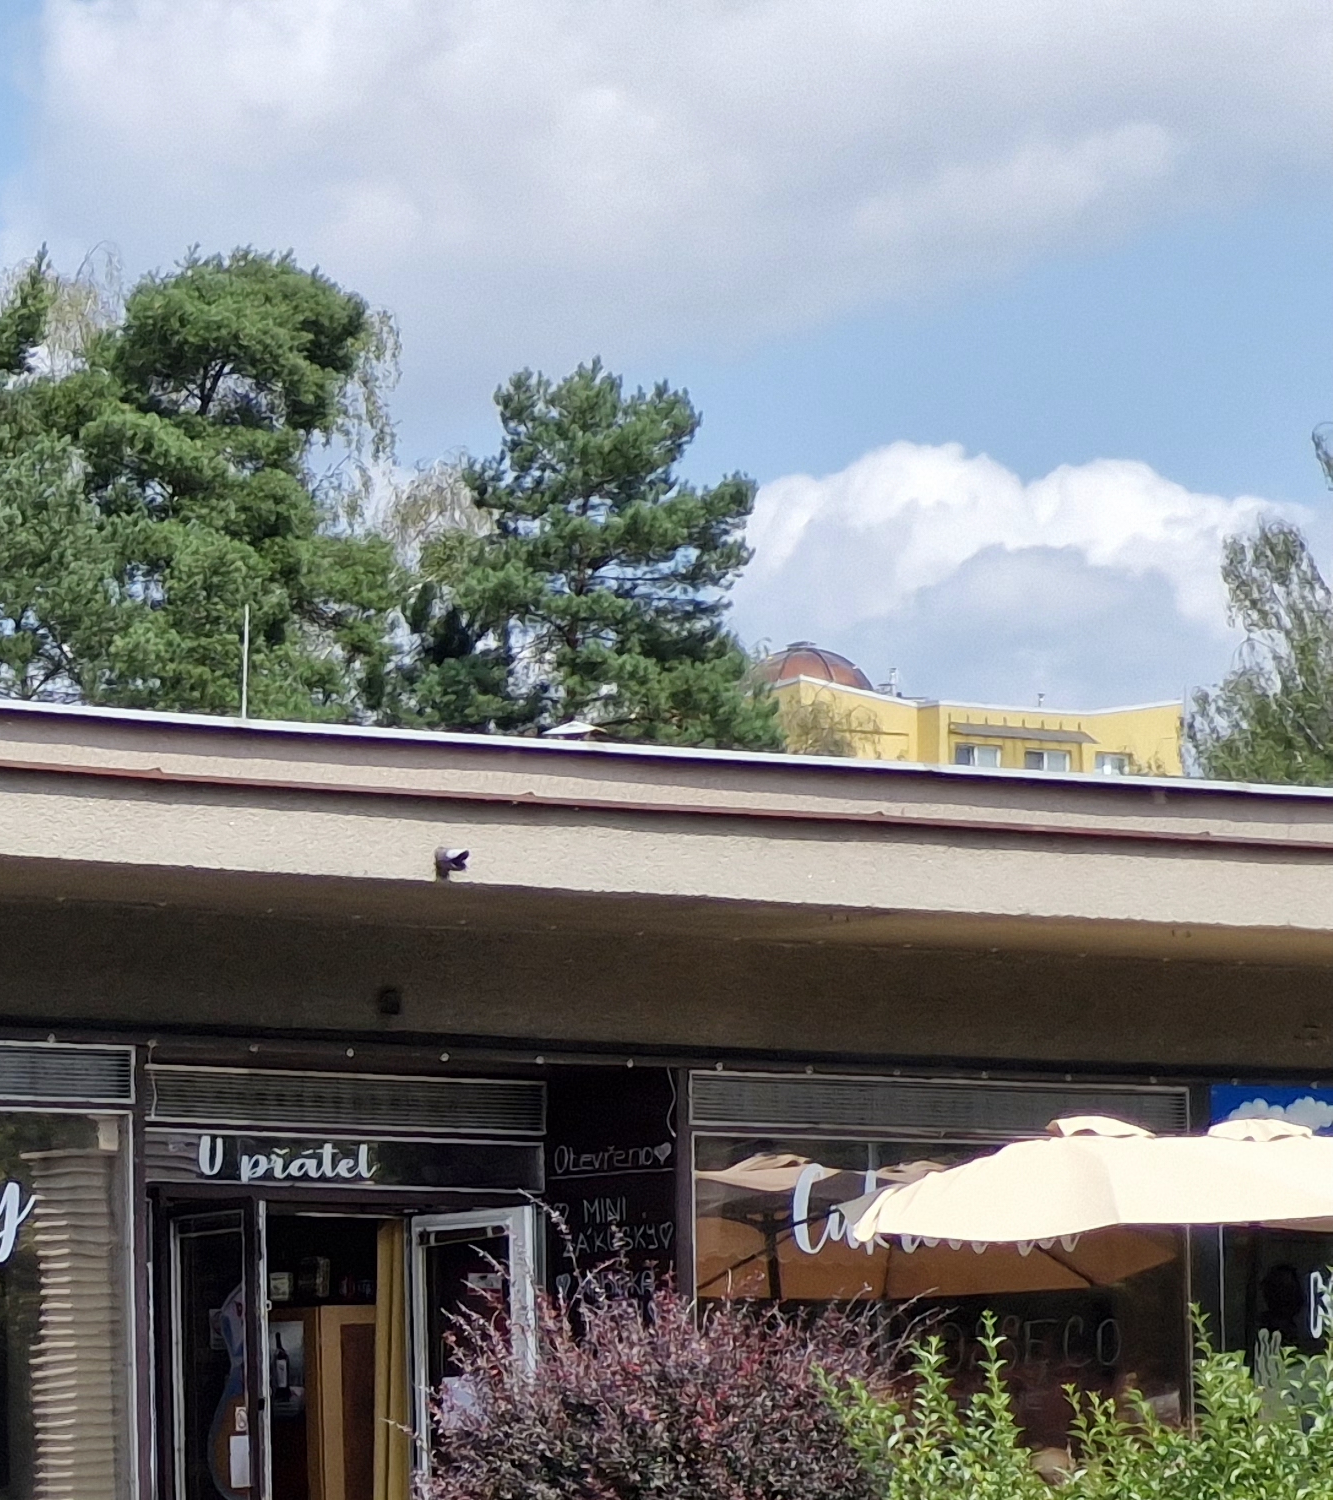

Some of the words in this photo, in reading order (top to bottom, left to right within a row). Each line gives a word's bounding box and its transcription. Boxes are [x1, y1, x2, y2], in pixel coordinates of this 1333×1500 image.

[198, 1135, 223, 1176] U
[240, 1142, 380, 1183] přátel
[554, 1144, 654, 1174] Otevřeno
[583, 1196, 627, 1223] MINI
